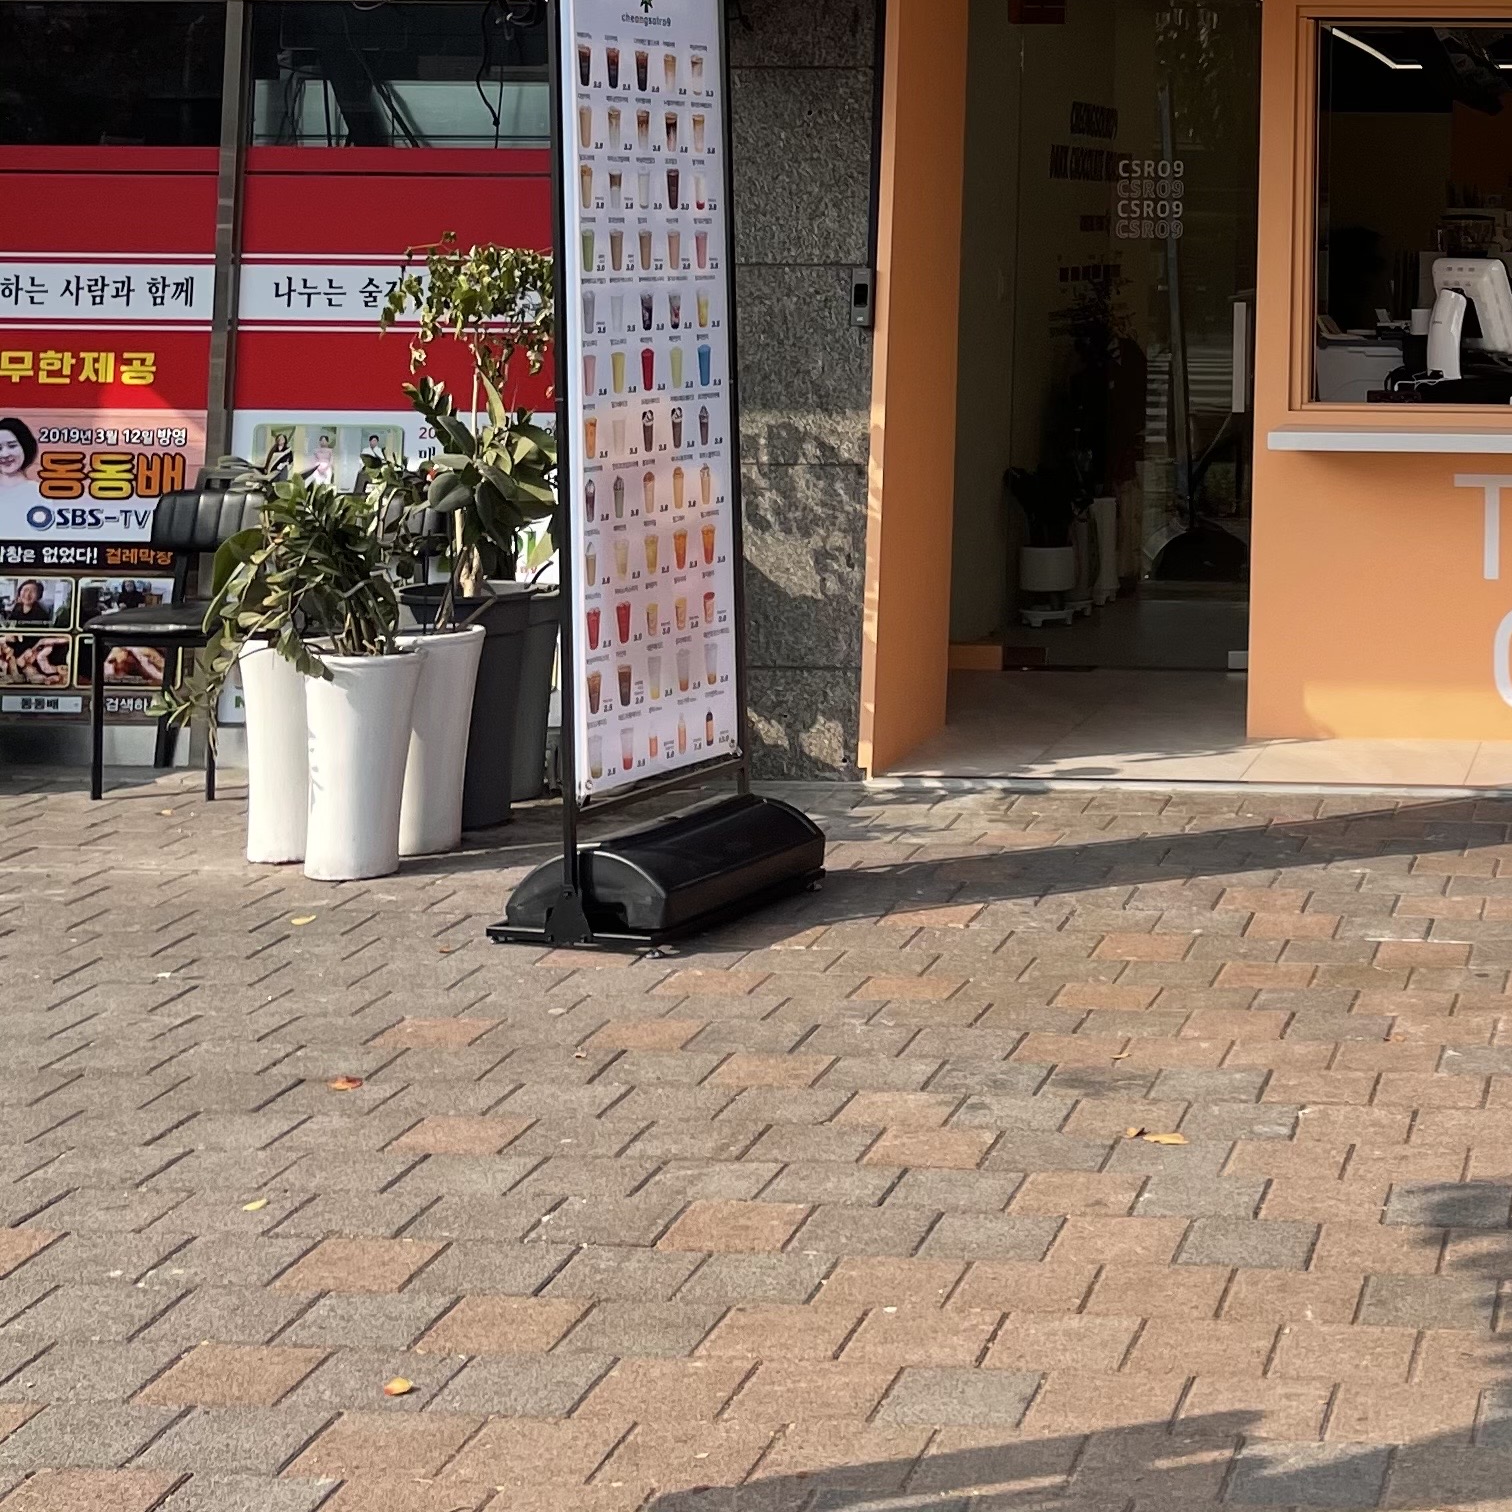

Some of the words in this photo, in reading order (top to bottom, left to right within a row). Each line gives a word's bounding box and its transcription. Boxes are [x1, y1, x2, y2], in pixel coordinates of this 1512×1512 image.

[60, 274, 135, 307] 사람과
[146, 274, 195, 307] 함께
[274, 276, 348, 308] 나누는
[0, 350, 157, 385] 무한제공
[39, 428, 92, 445] 2019년
[95, 428, 118, 445] 3월
[122, 429, 153, 445] 12일
[156, 428, 187, 446] 방영
[37, 451, 187, 500] 동동배
[42, 547, 98, 564] 없었다!
[105, 696, 155, 713] 검색하
